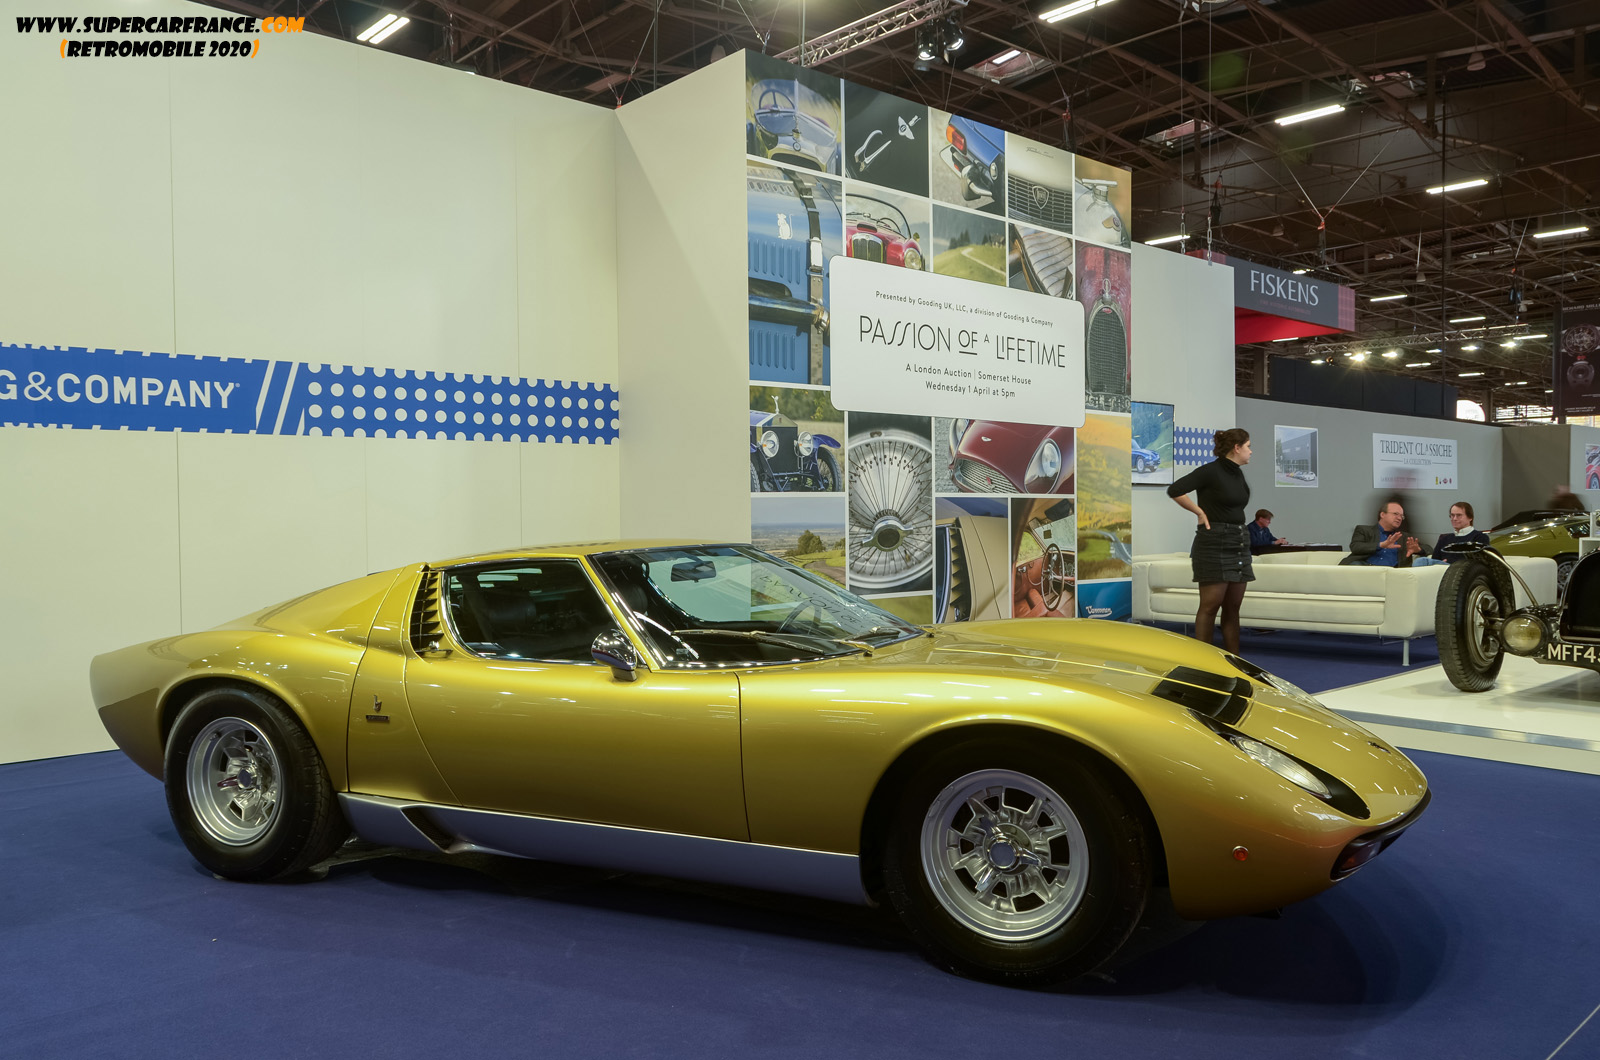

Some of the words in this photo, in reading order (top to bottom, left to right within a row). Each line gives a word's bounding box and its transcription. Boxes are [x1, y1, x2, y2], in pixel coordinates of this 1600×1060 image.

[1250, 269, 1319, 306] FISKENS
[875, 290, 907, 303] Presented
[908, 296, 916, 306] by
[917, 297, 942, 310] Gooding
[943, 302, 955, 311] UK,
[955, 304, 969, 314] LLC,
[974, 307, 995, 318] division
[1003, 312, 1025, 324] Gooding
[1025, 315, 1030, 323] &
[1030, 316, 1054, 328] Company
[859, 315, 951, 353] PASSION
[957, 329, 978, 355] OF
[983, 333, 990, 344] A
[996, 334, 1066, 368] LIFETIME
[905, 363, 912, 372] A
[913, 363, 942, 375] London
[943, 367, 972, 379] Auction
[977, 370, 1010, 382] Somerset
[1011, 374, 1032, 385] House
[925, 380, 966, 395] Wednesday
[967, 385, 971, 393] 1
[973, 386, 991, 399] April
[992, 388, 999, 396] at
[1001, 388, 1016, 399] 5pm
[1380, 440, 1413, 455] TRIDENT
[1414, 442, 1452, 458] CLASSICHE
[1547, 643, 1600, 664] MFF4
